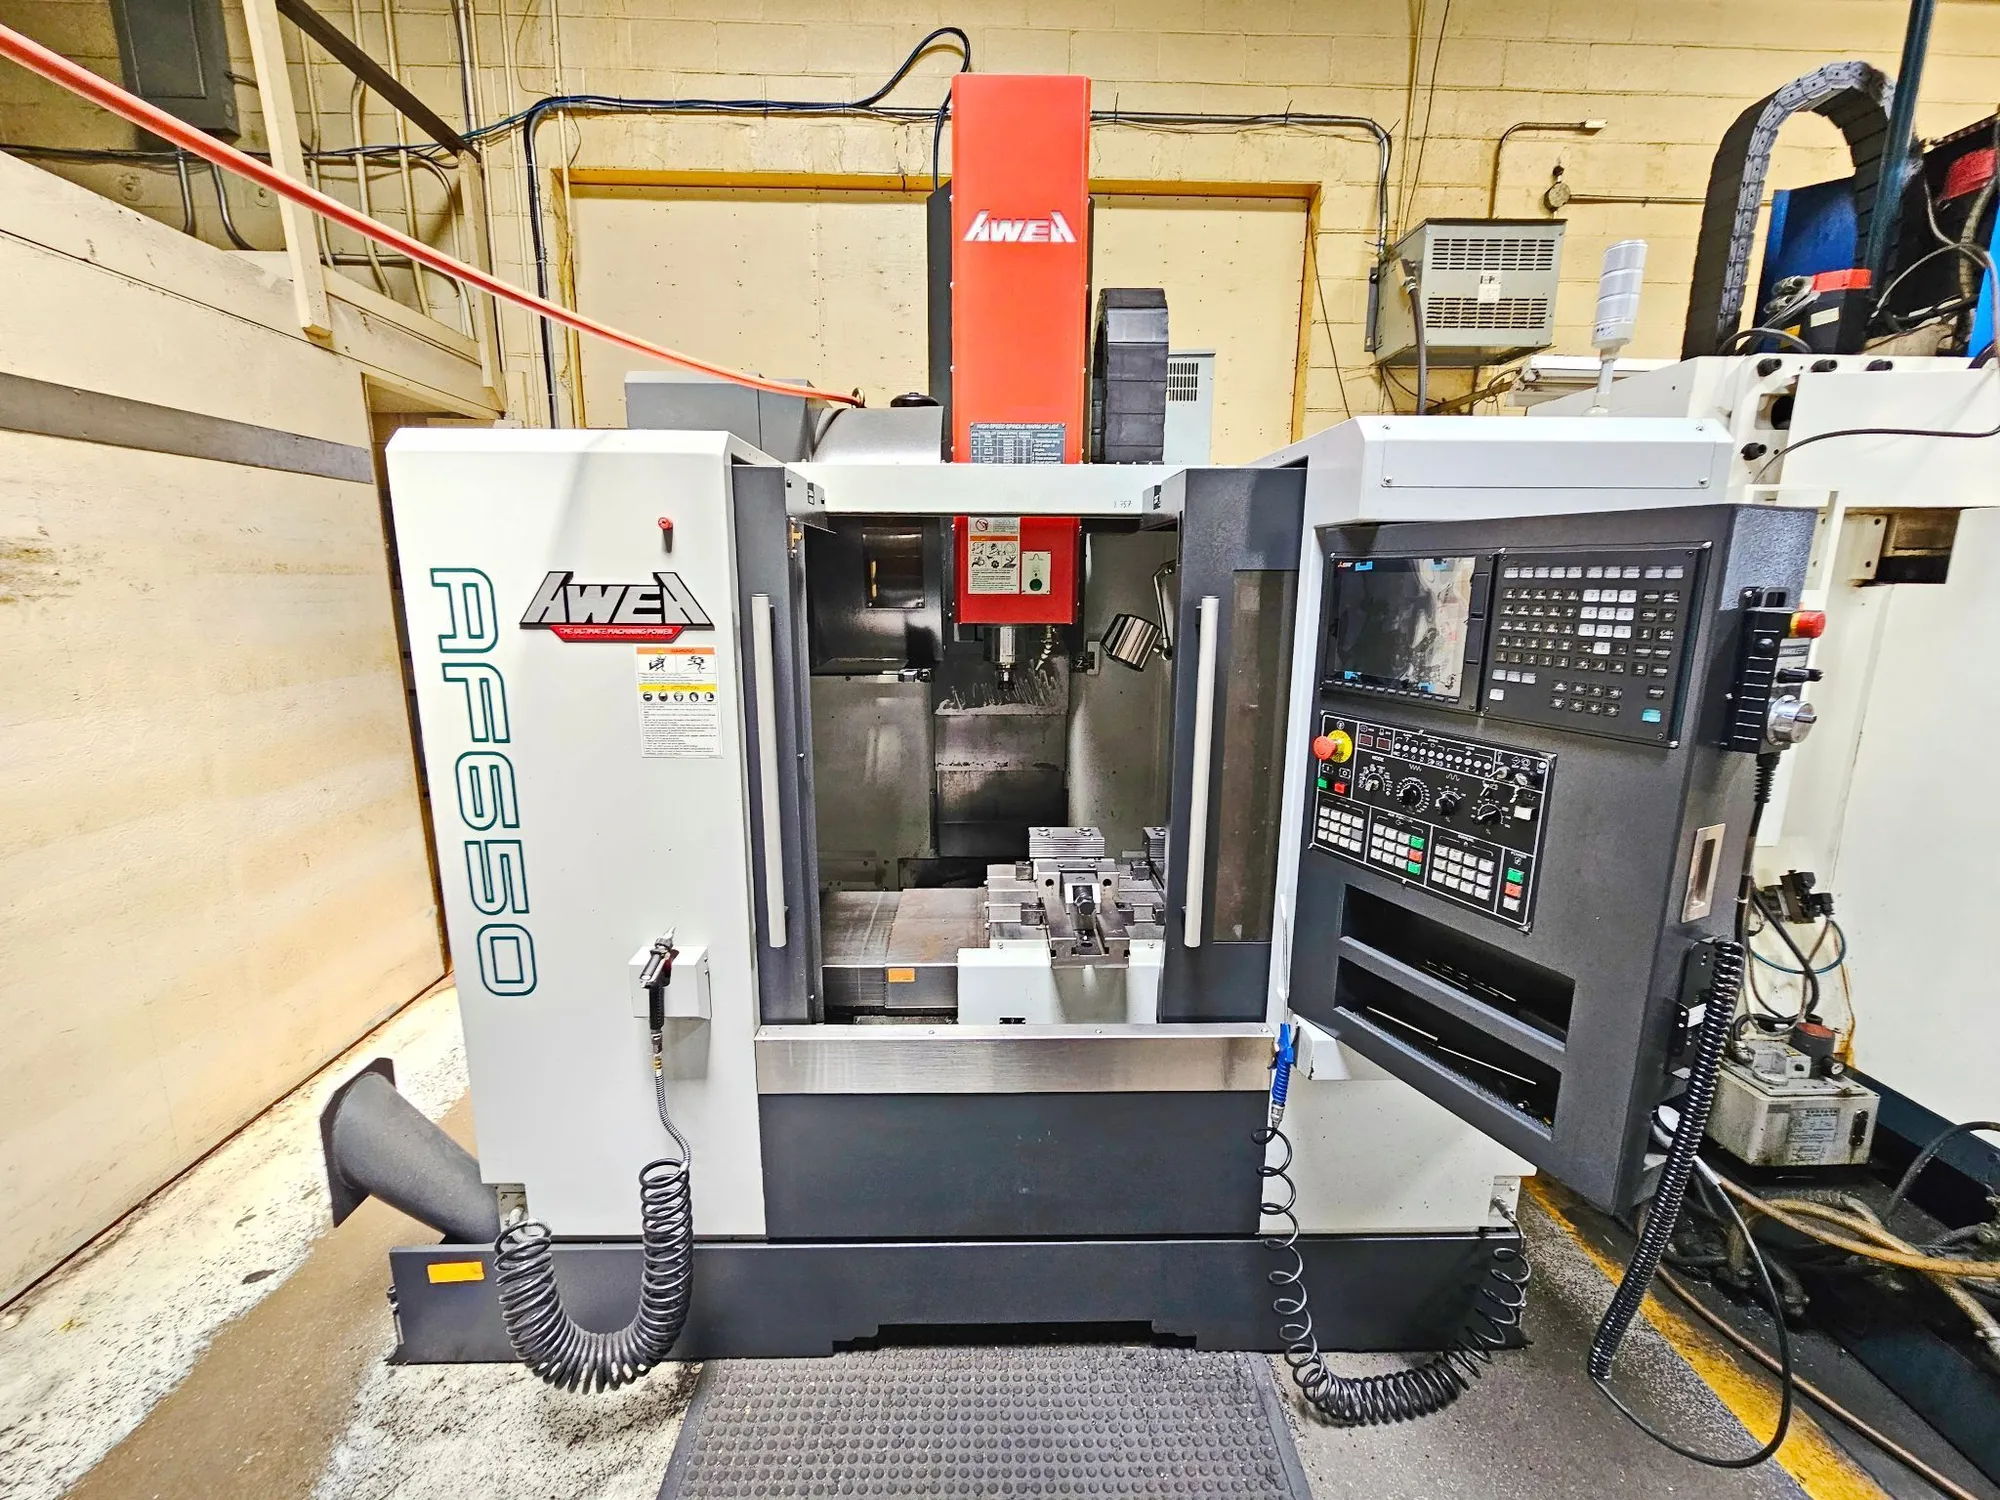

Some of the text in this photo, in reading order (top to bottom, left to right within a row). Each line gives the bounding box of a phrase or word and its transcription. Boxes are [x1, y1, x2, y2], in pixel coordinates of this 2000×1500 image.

[962, 209, 1077, 243] AWEA
[519, 571, 714, 627] AWEA
[429, 567, 538, 997] AF650
